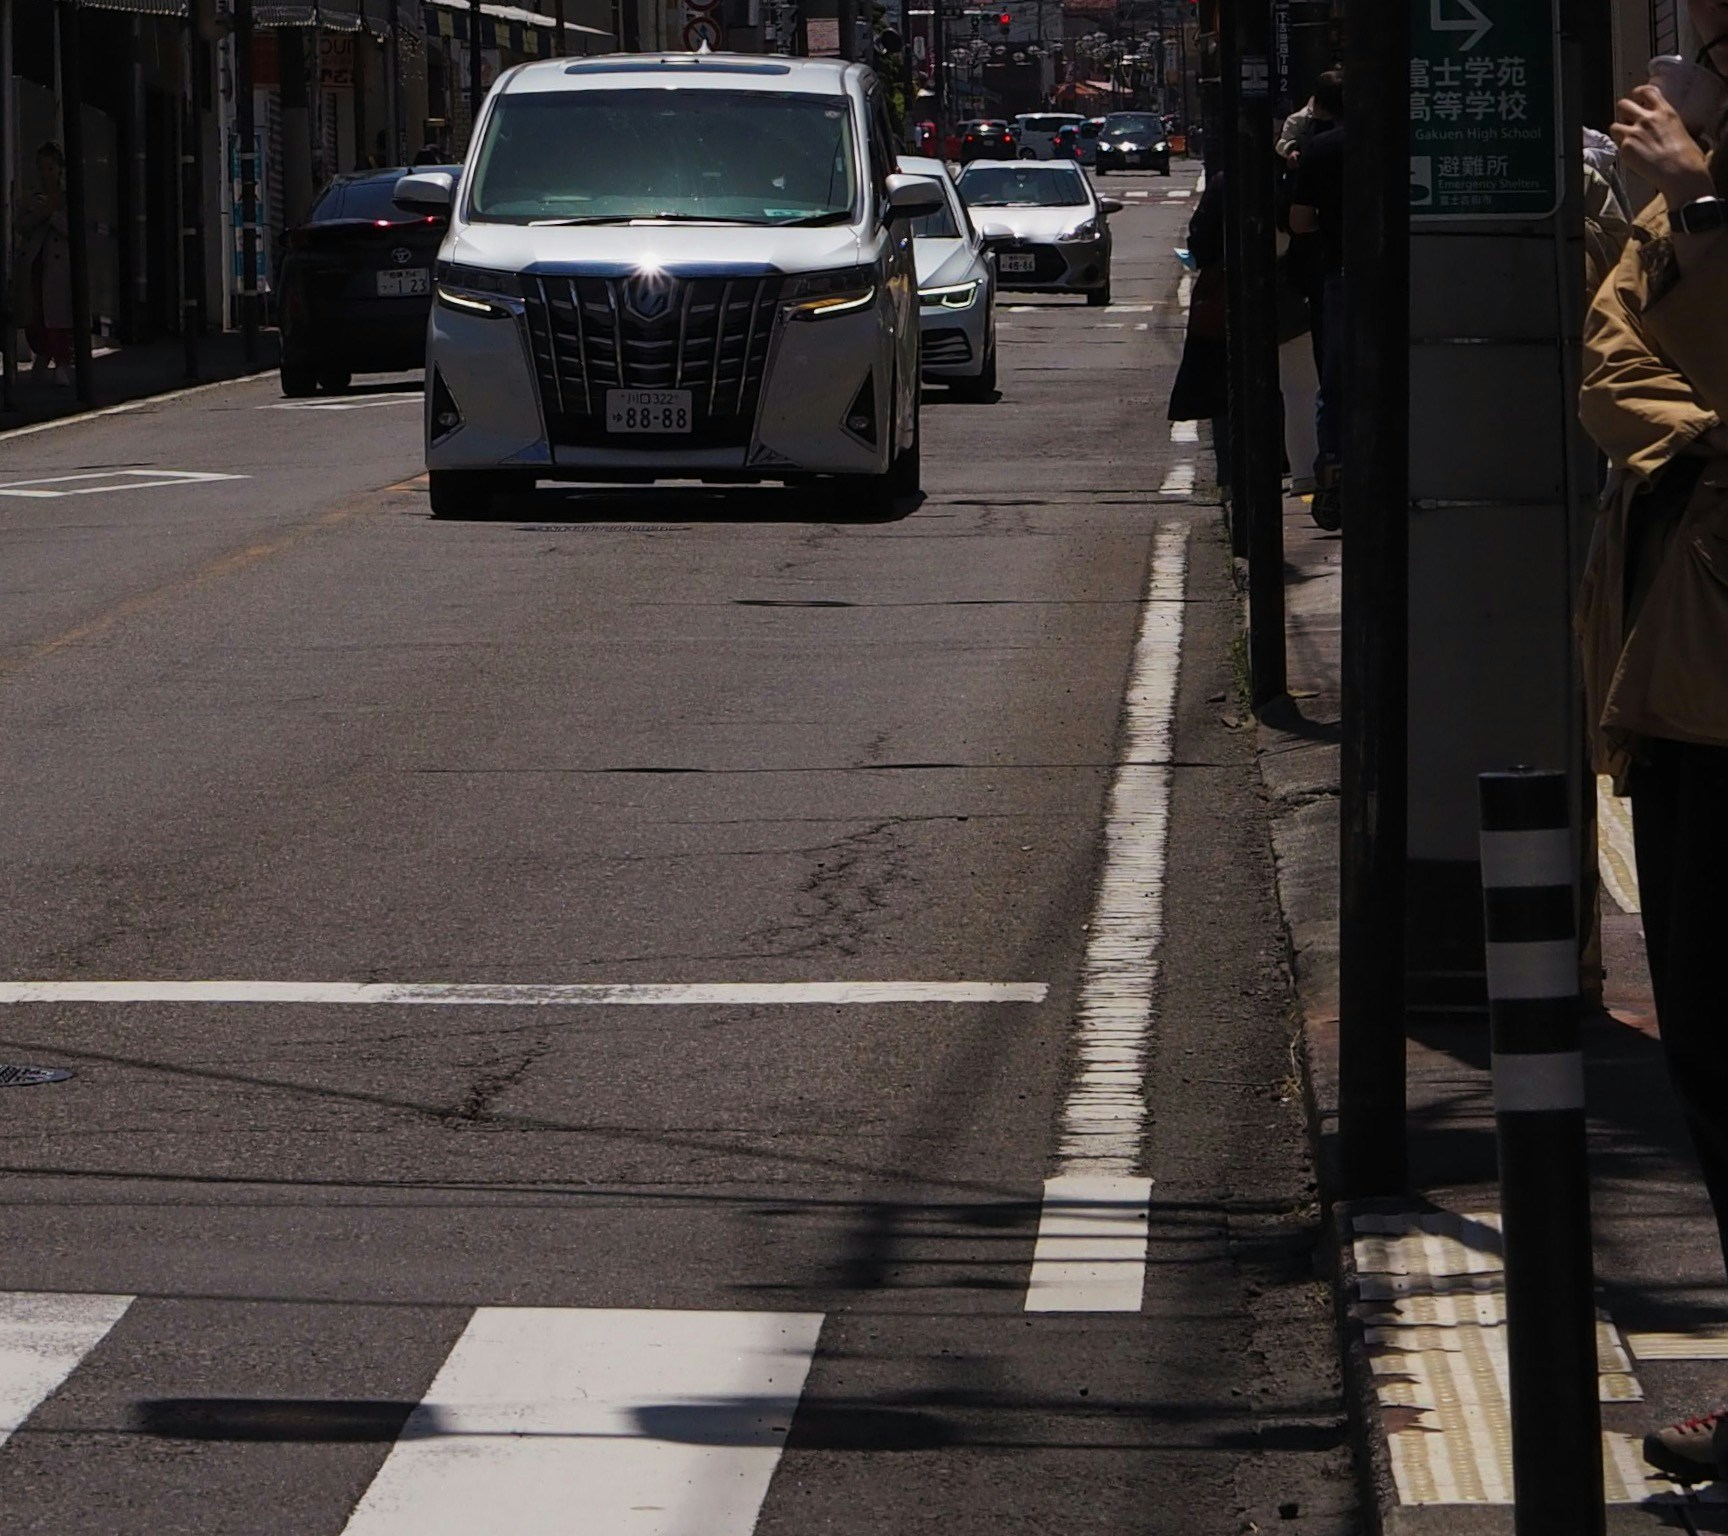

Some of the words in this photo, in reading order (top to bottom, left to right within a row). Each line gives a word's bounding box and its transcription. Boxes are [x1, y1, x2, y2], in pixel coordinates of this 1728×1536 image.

[1410, 56, 1526, 88] 富士学苑
[1410, 89, 1528, 122] 高等学校
[1414, 128, 1464, 140] Gakuen
[1467, 128, 1497, 142] High
[1501, 128, 1542, 140] School
[1438, 155, 1510, 177] 避難所
[1438, 180, 1496, 190] Emergency
[1500, 178, 1540, 189] Shelters
